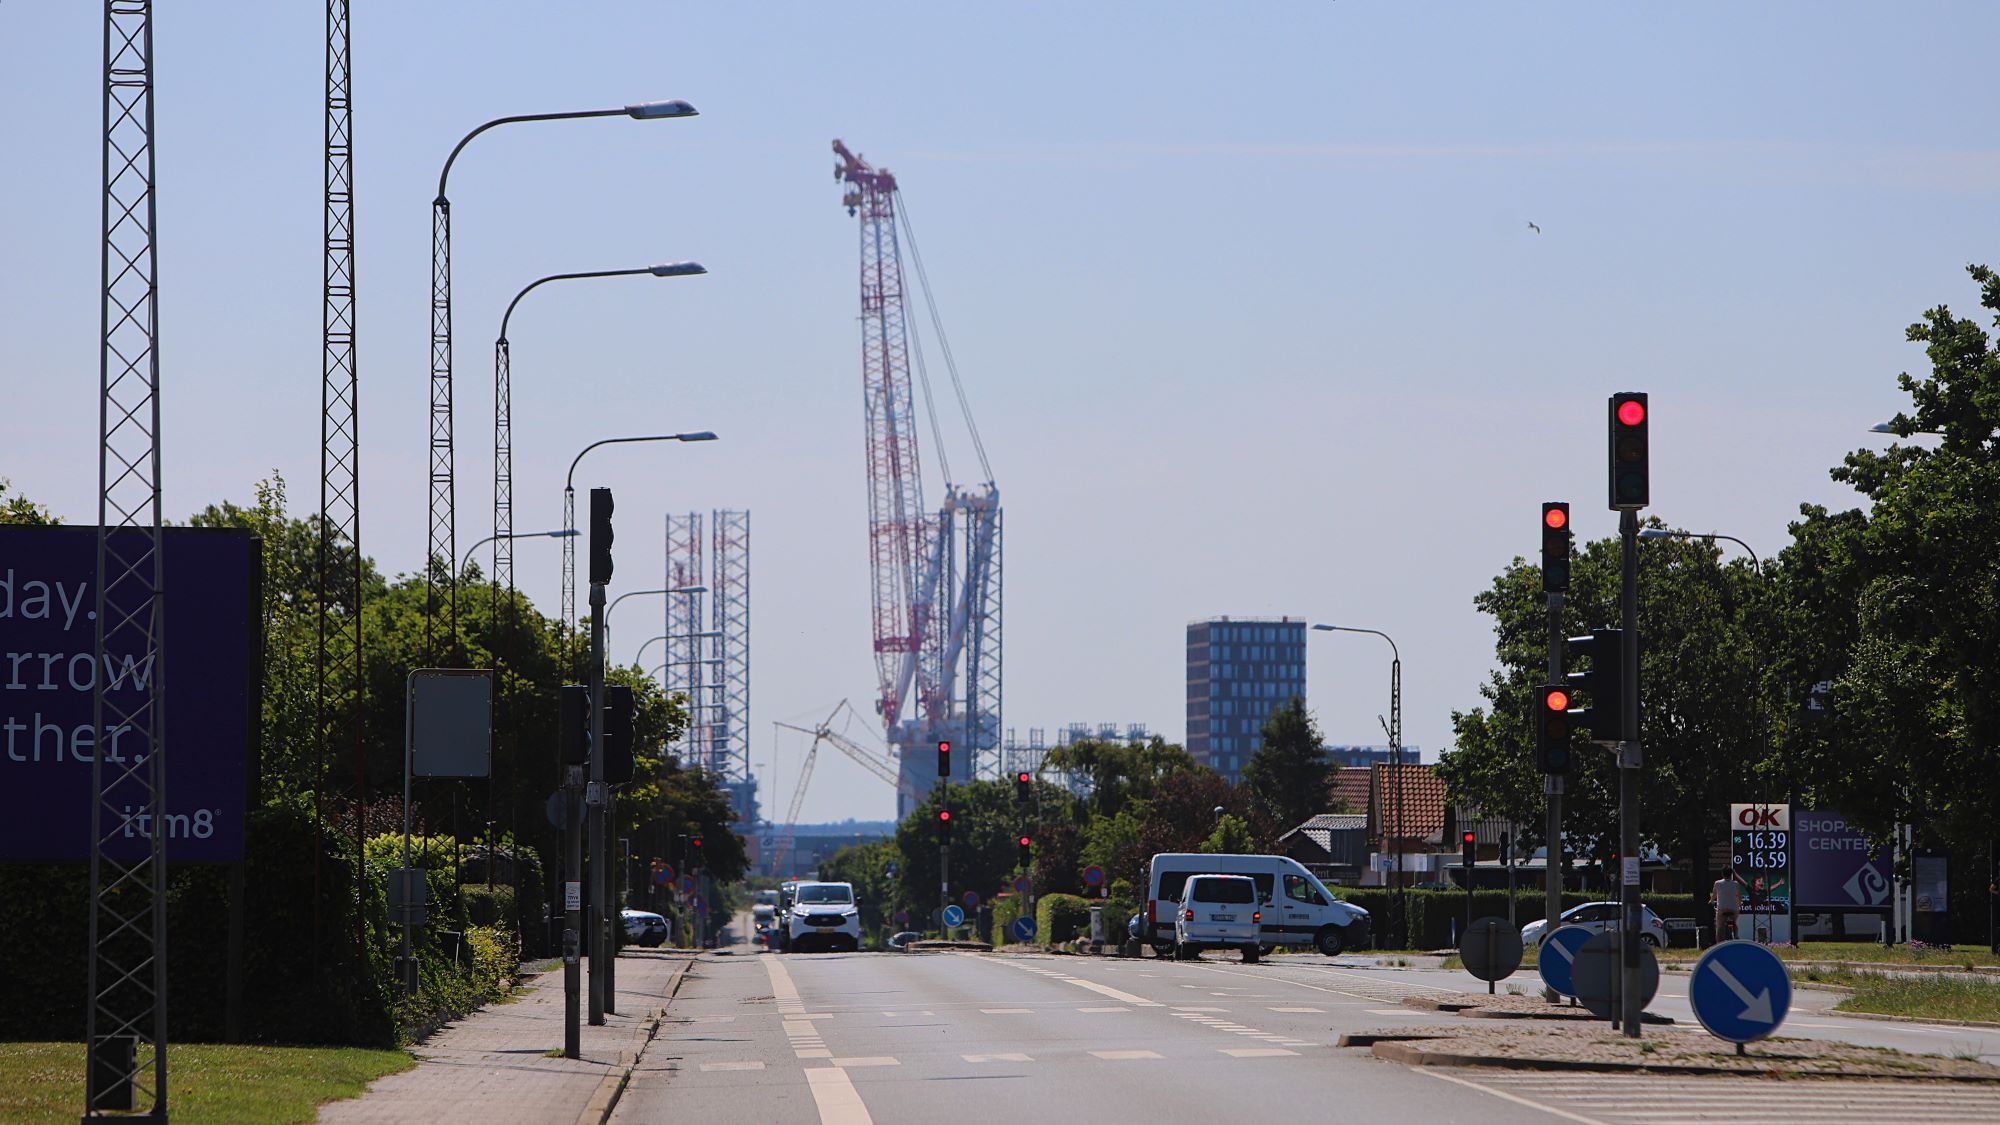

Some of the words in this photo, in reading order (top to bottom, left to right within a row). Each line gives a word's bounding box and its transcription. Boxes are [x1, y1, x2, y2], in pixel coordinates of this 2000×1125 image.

[3, 712, 144, 763] ther.
[1739, 808, 1782, 826] OK
[1747, 832, 1786, 849] 16.39
[1747, 851, 1786, 868] 16.59
